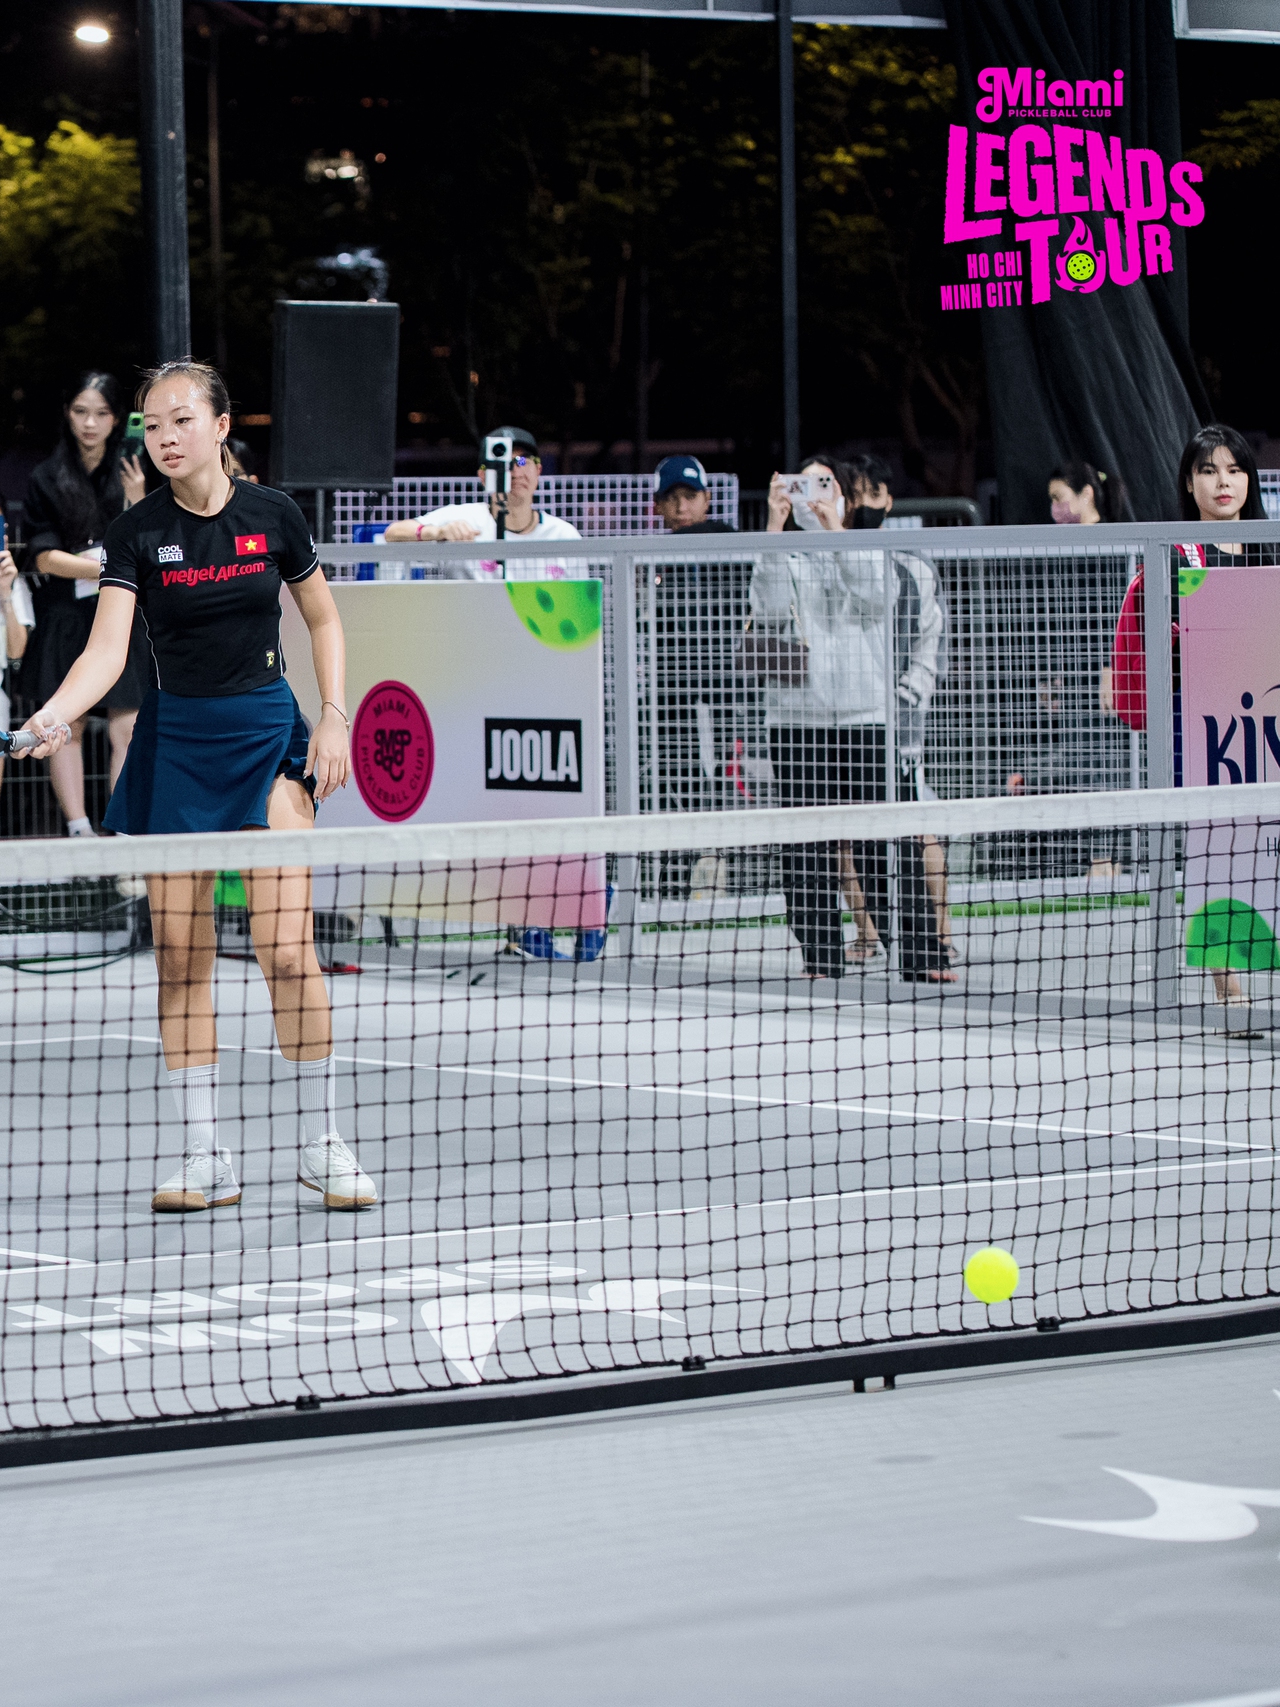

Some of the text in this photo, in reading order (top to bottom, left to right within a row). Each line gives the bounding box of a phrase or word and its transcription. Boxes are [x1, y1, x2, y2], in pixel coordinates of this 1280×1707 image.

[158, 545, 183, 554] COOL
[159, 553, 184, 562] MATE
[373, 699, 411, 719] MIAMI
[487, 729, 579, 782] JOOLA
